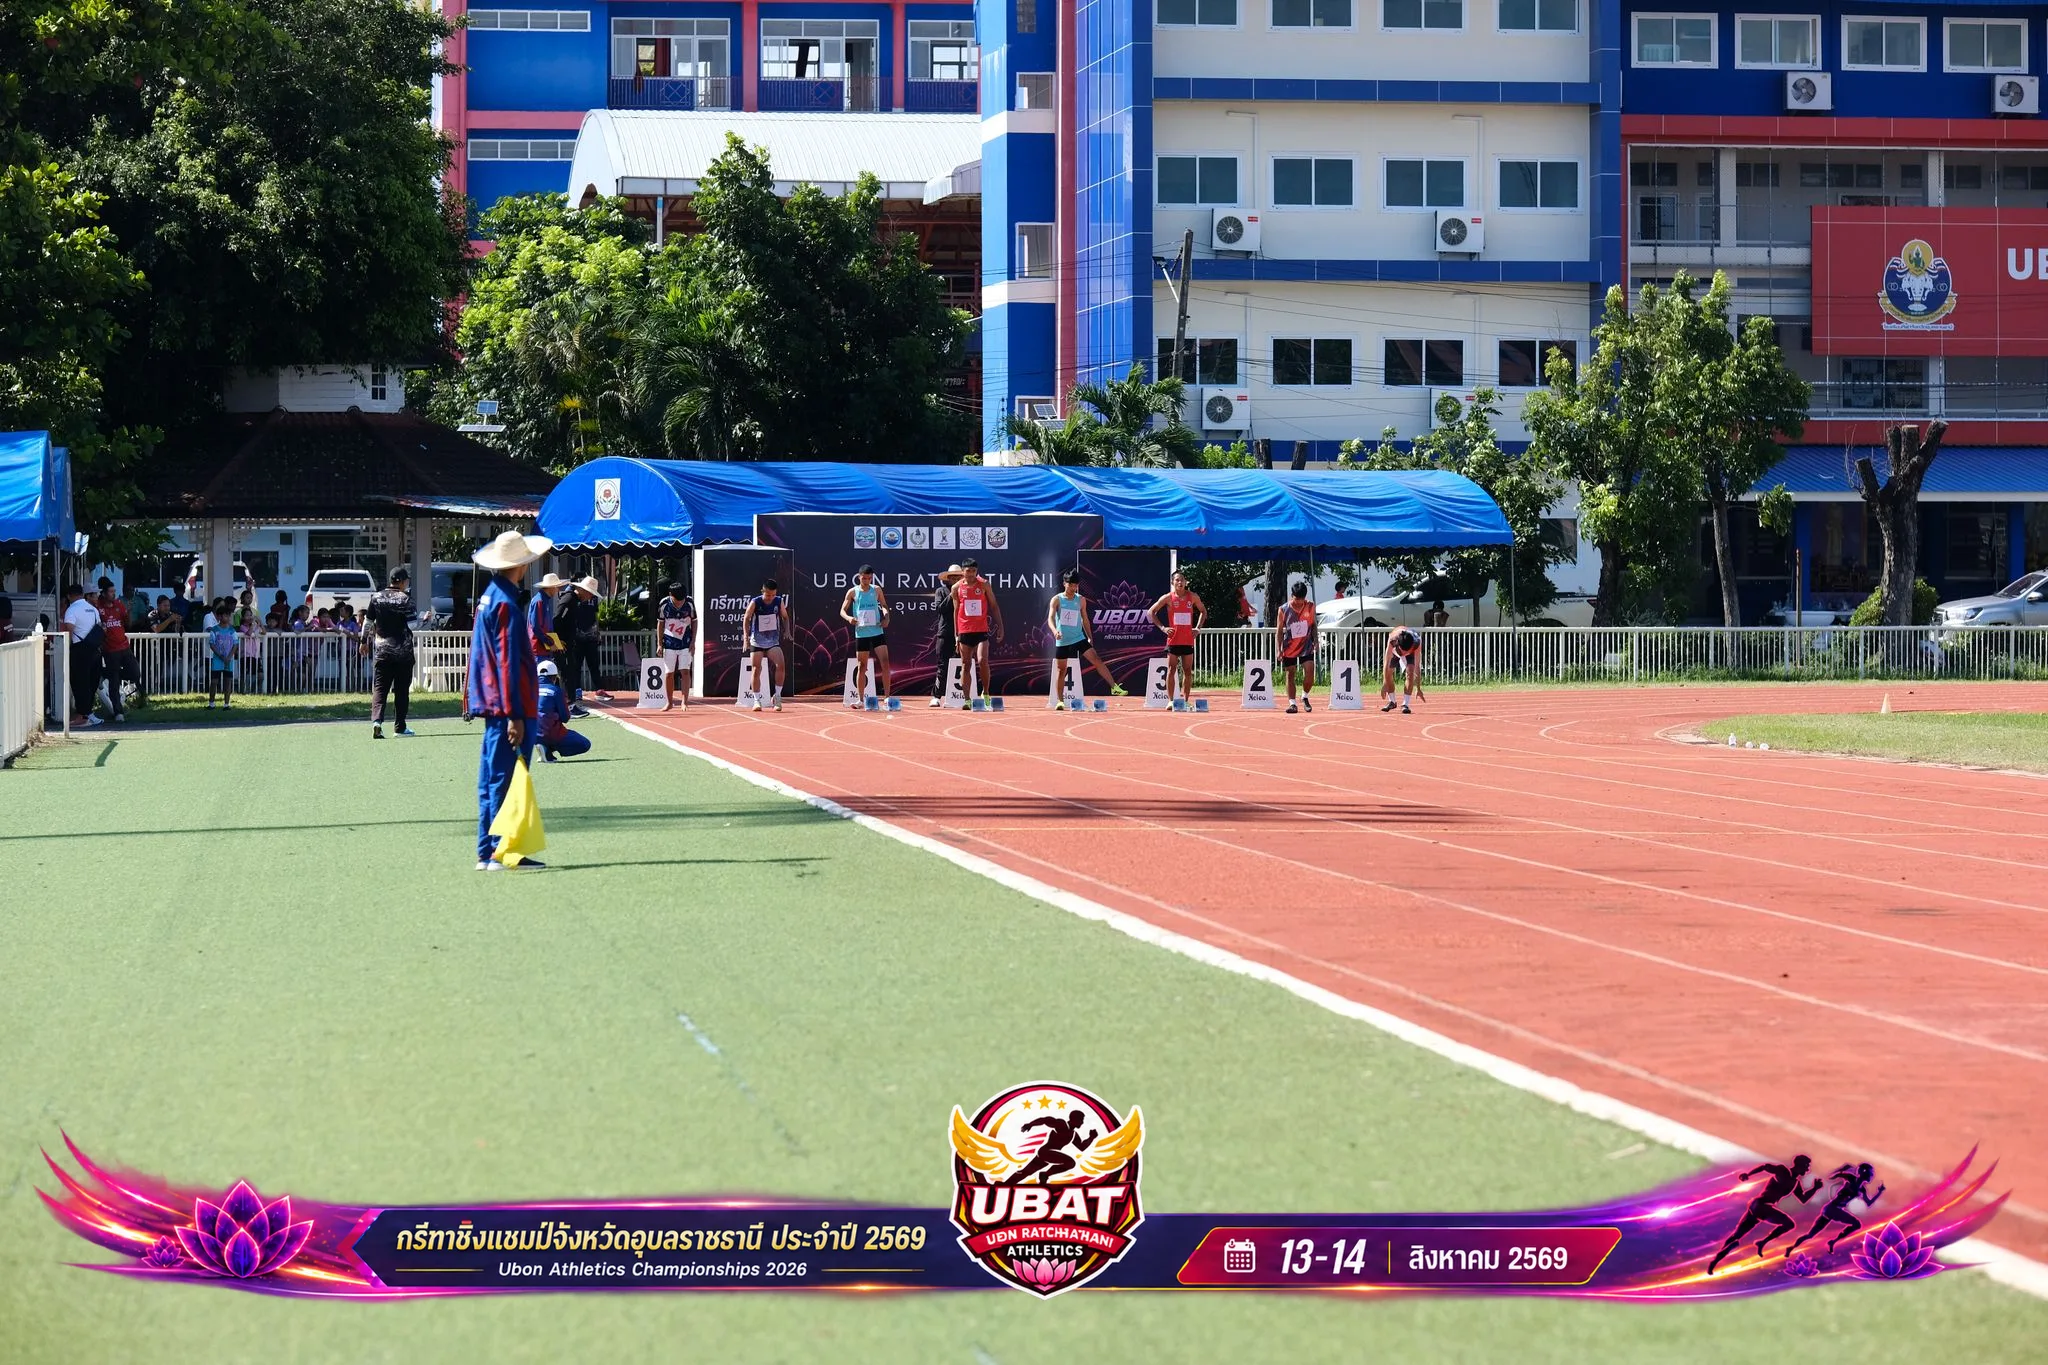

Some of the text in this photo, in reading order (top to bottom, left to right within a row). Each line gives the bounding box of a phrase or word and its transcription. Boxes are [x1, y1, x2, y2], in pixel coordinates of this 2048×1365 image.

[897, 573, 1054, 588] RATTHANI
[1064, 610, 1072, 622] 4
[1092, 609, 1154, 624] UBON
[668, 623, 684, 636] 14
[1093, 624, 1155, 633] ATHLETICS
[647, 665, 663, 690] 8
[1064, 667, 1075, 691] 4
[1155, 666, 1168, 690] 3
[1250, 667, 1266, 691] 2
[1340, 667, 1352, 692] 1
